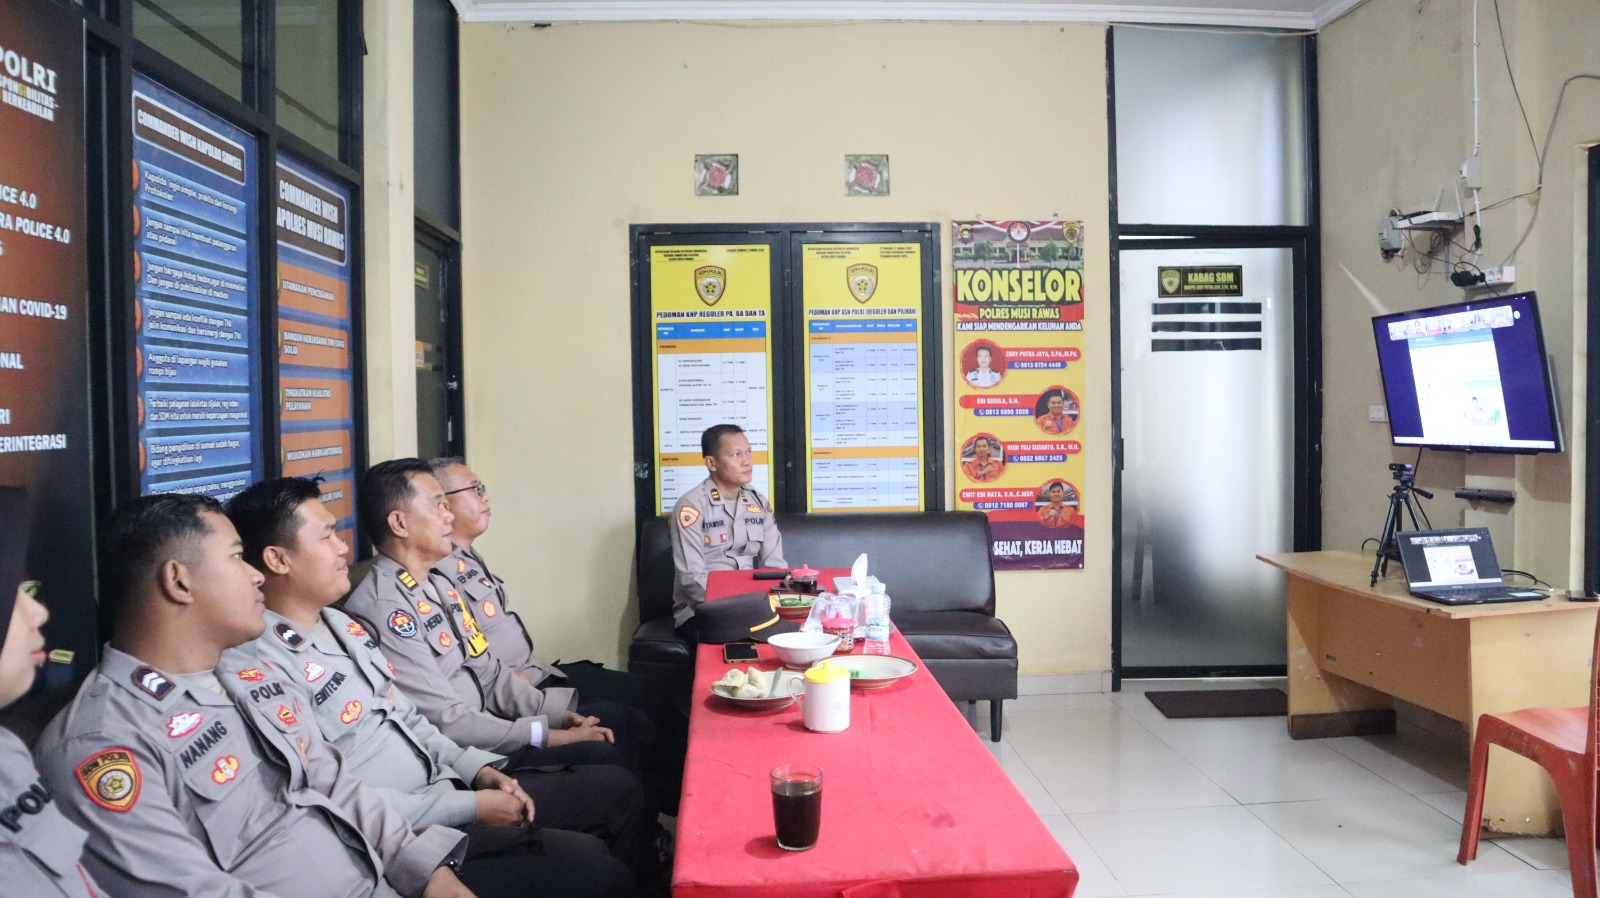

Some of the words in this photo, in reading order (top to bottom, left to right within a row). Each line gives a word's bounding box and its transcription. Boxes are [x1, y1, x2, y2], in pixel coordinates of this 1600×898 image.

[138, 109, 180, 142] COMMANDER
[180, 130, 196, 150] WISH
[196, 137, 222, 162] KAPOLDA
[19, 190, 38, 209] 4.0
[280, 180, 322, 216] COMMANDER
[322, 200, 339, 224] WISH
[16, 216, 54, 240] POLICE
[54, 226, 71, 244] 4.0
[306, 218, 324, 242] MUSI
[324, 226, 345, 251] RAWAS
[956, 269, 1082, 302] KONSELOR
[1188, 272, 1214, 282] KABAG
[1216, 272, 1234, 282] SDM
[20, 299, 68, 320] COVID-19
[980, 308, 1009, 319] POLRES
[1011, 308, 1030, 319] MUSI
[1032, 307, 1059, 319] RAWAS
[957, 322, 973, 330] KAMI
[974, 322, 987, 330] SIAP
[988, 322, 1037, 330] MENDENGARKAN
[1038, 322, 1064, 330] KELUHAN
[1065, 322, 1082, 330] ANDA
[284, 344, 298, 355] SOLID
[0, 352, 24, 370] NAL
[0, 434, 66, 452] ERINTEGRASI
[993, 540, 1023, 557] SEHAT,
[1025, 540, 1052, 555] KERJA
[1054, 540, 1082, 554] HEBAT
[424, 612, 443, 632] HERDI
[180, 721, 227, 769] NANANG
[101, 752, 130, 764] POLRI
